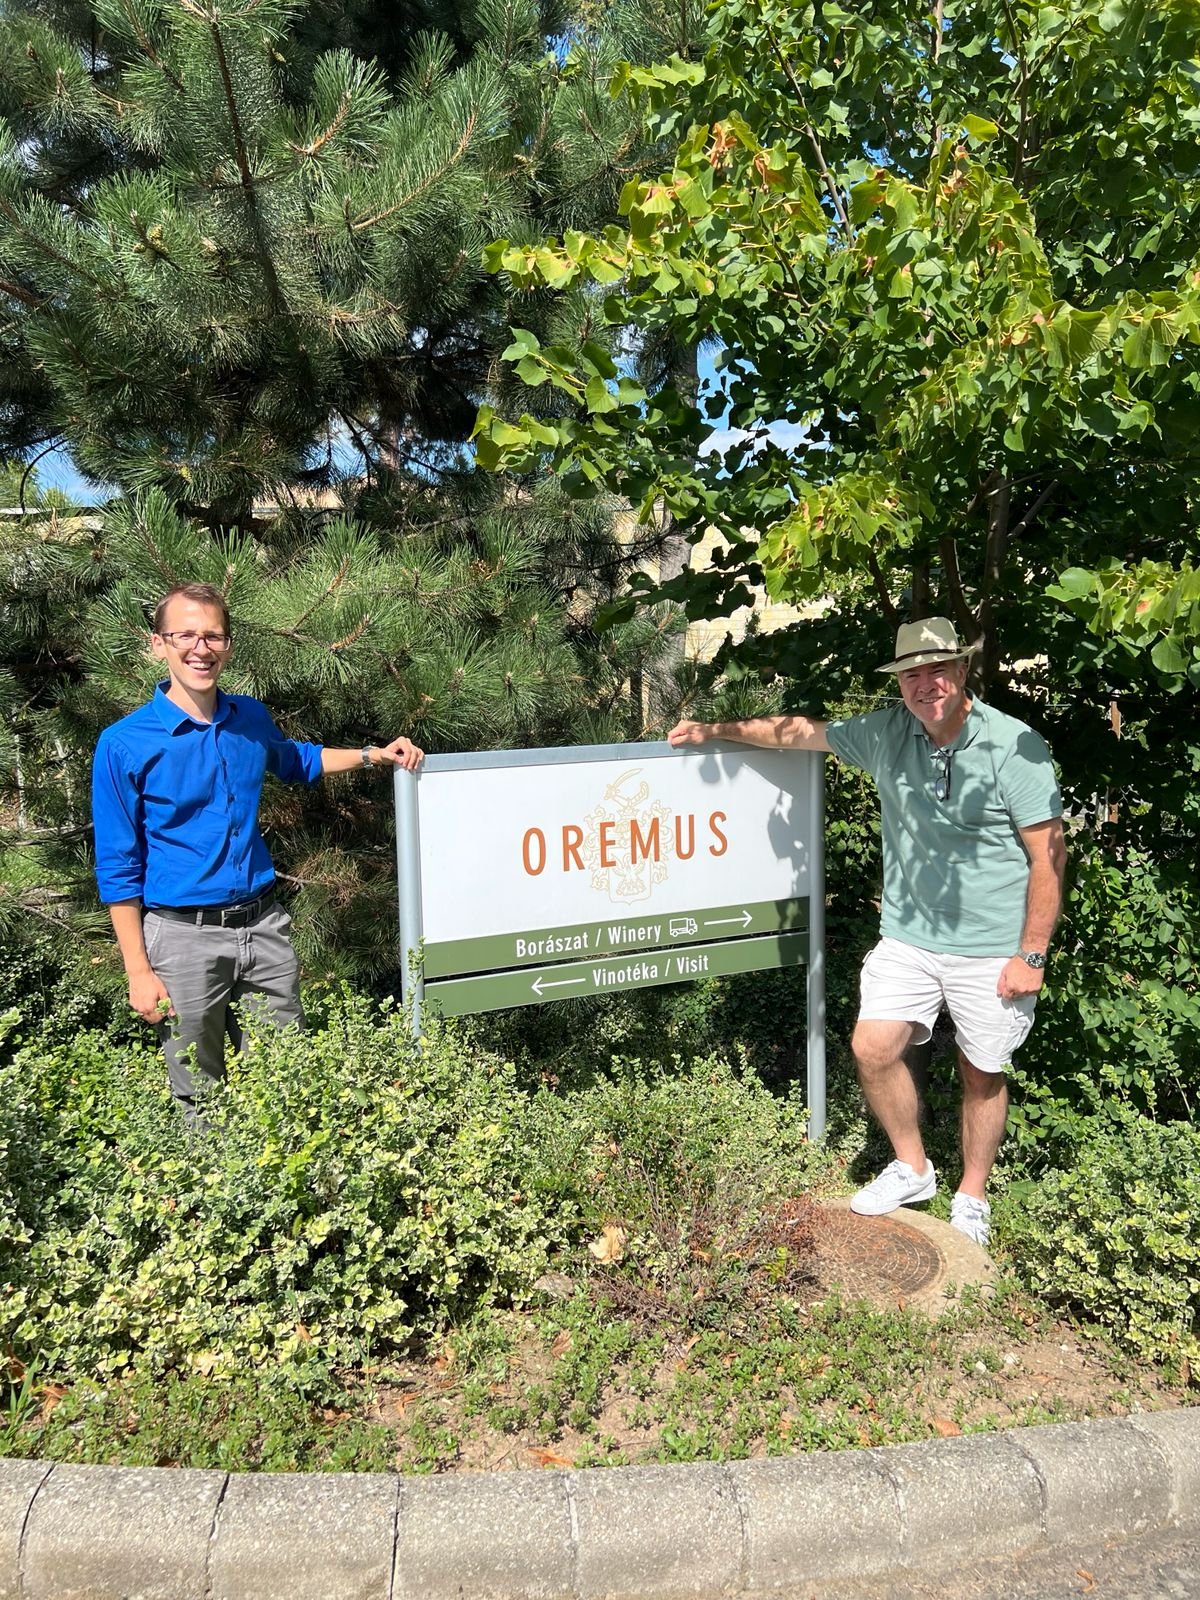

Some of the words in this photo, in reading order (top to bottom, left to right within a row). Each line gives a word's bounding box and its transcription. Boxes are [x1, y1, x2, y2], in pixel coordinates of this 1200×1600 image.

[522, 811, 728, 876] OREMUS
[516, 932, 589, 957] Borászat
[595, 928, 602, 947] /
[608, 924, 662, 944] Winery
[593, 963, 658, 987] Vinotéka
[664, 958, 671, 977] /
[676, 955, 709, 974] Visit
